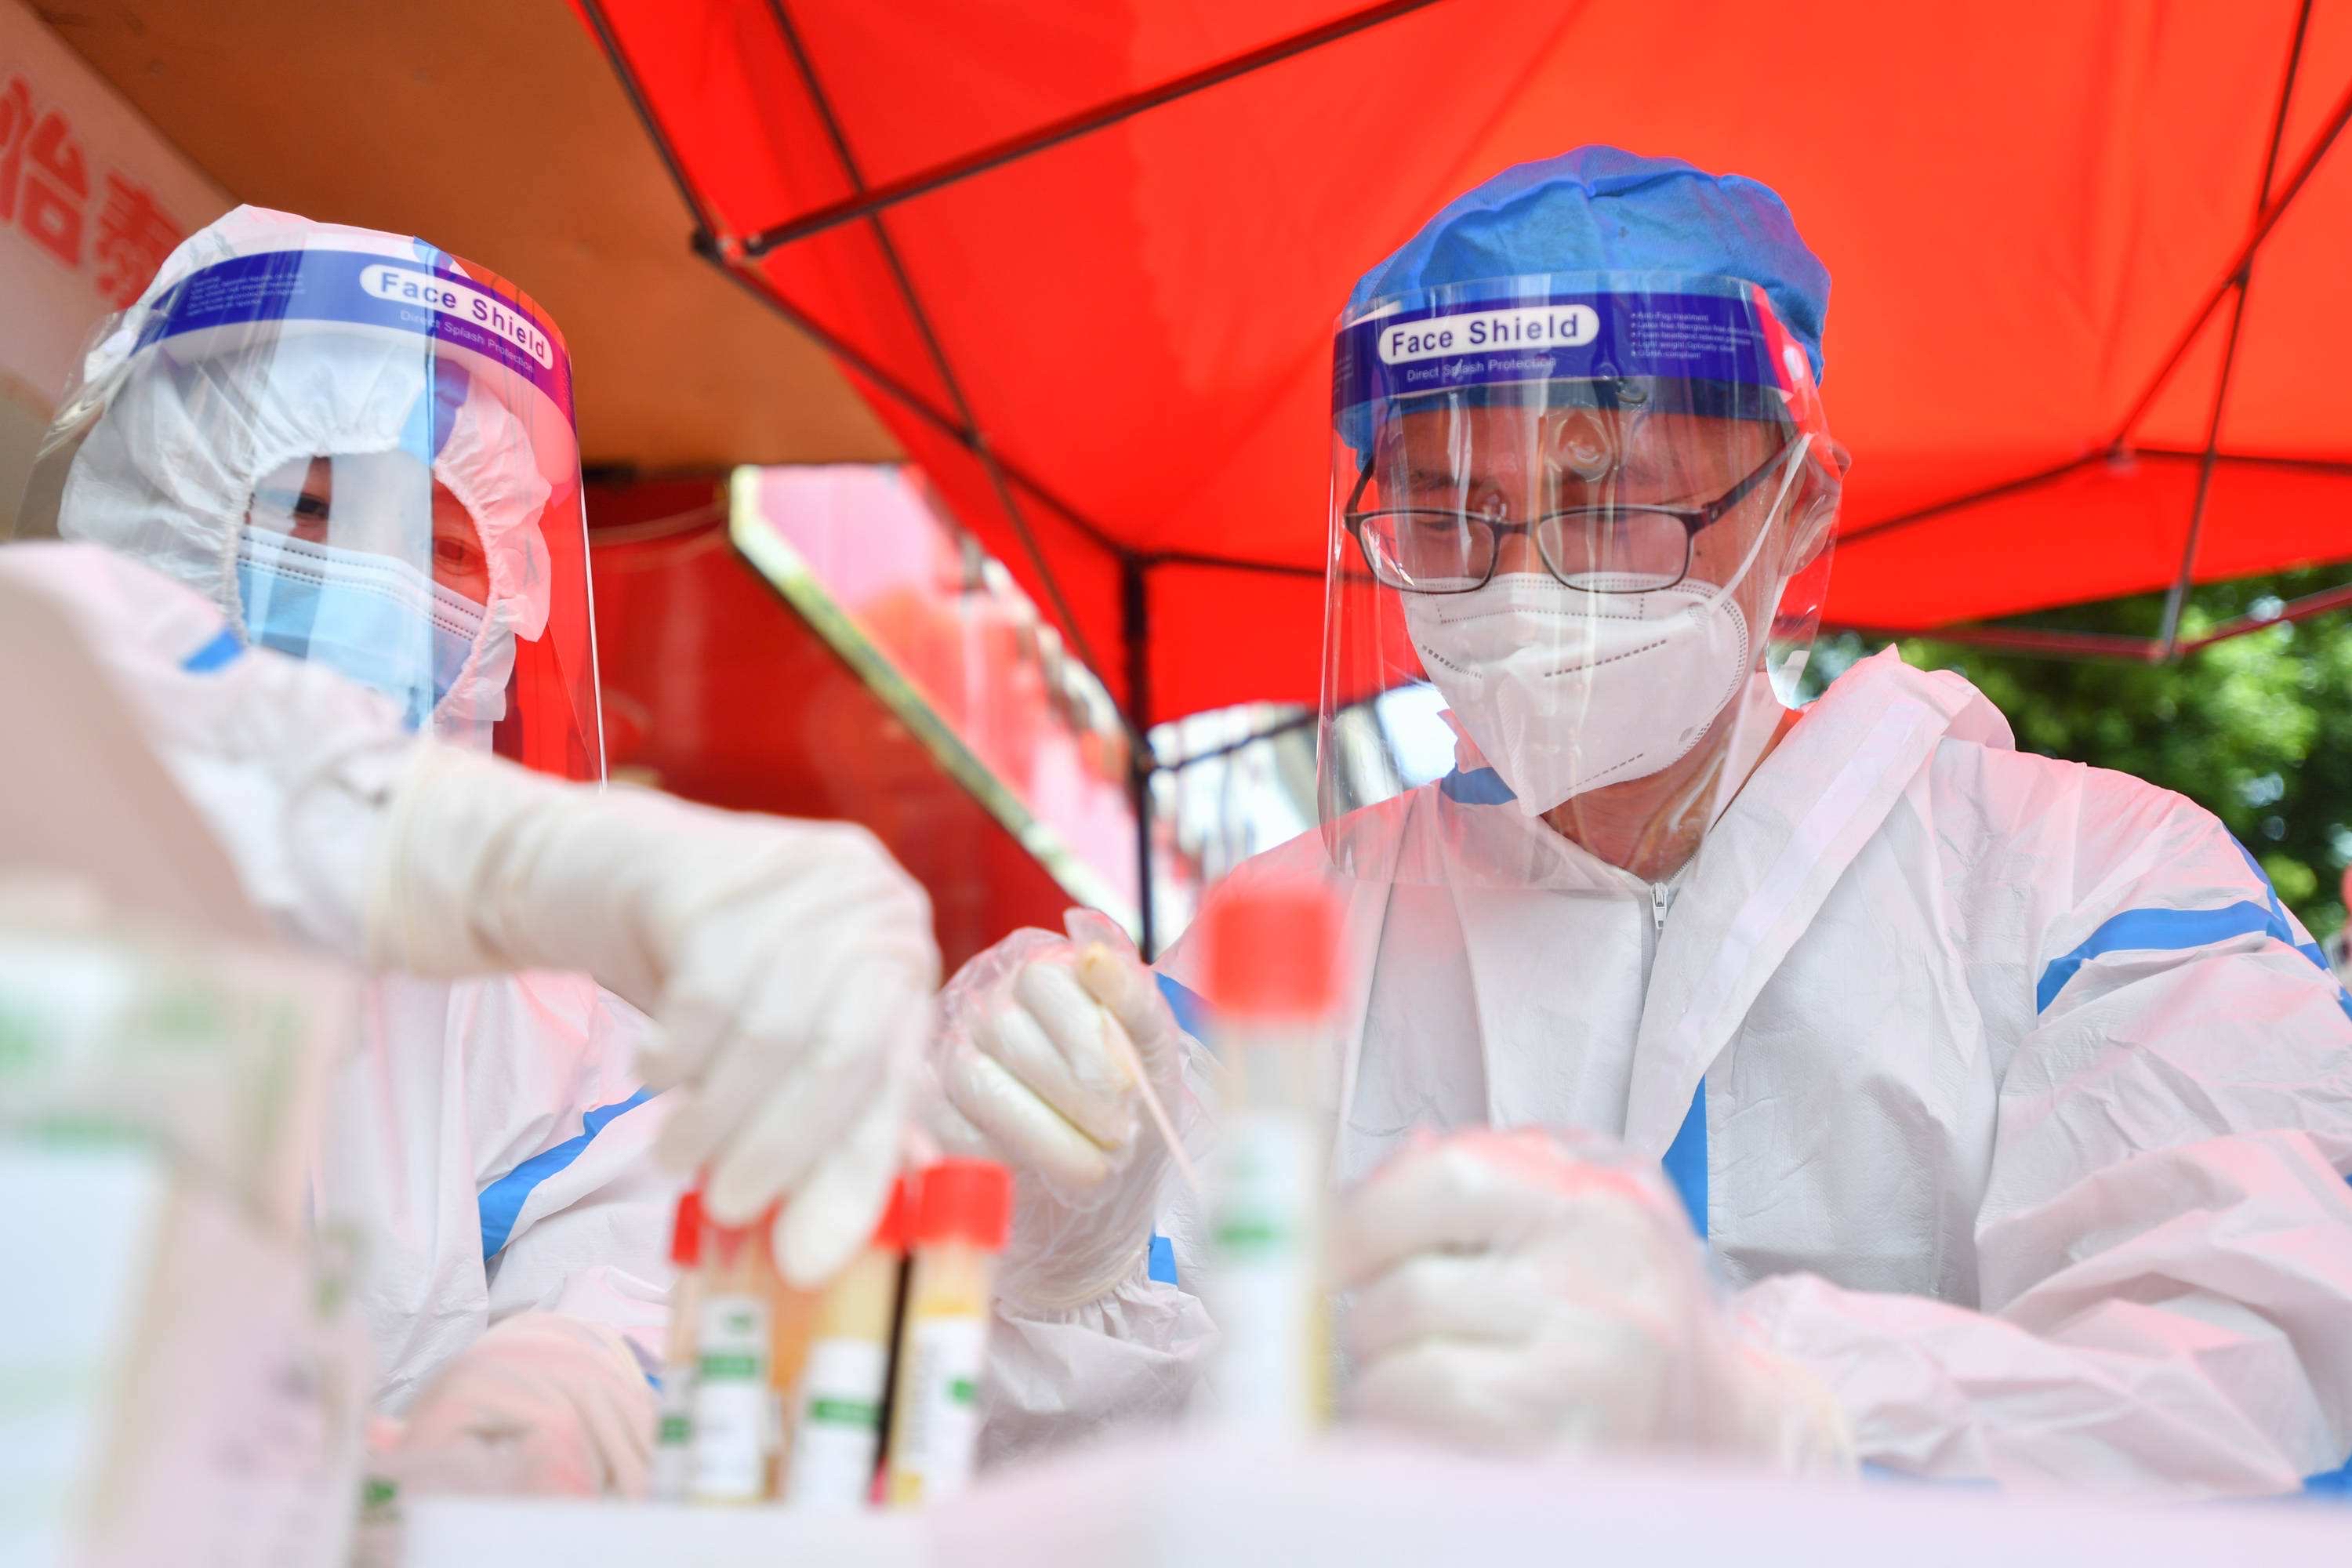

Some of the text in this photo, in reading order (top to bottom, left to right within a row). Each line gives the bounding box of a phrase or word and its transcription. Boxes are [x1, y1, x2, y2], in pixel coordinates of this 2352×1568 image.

[381, 272, 545, 358] Face Shield
[1392, 314, 1578, 357] Face Shield
[400, 310, 534, 374] Direct Splash Protection
[1407, 357, 1556, 382] Direct Splash Protection
